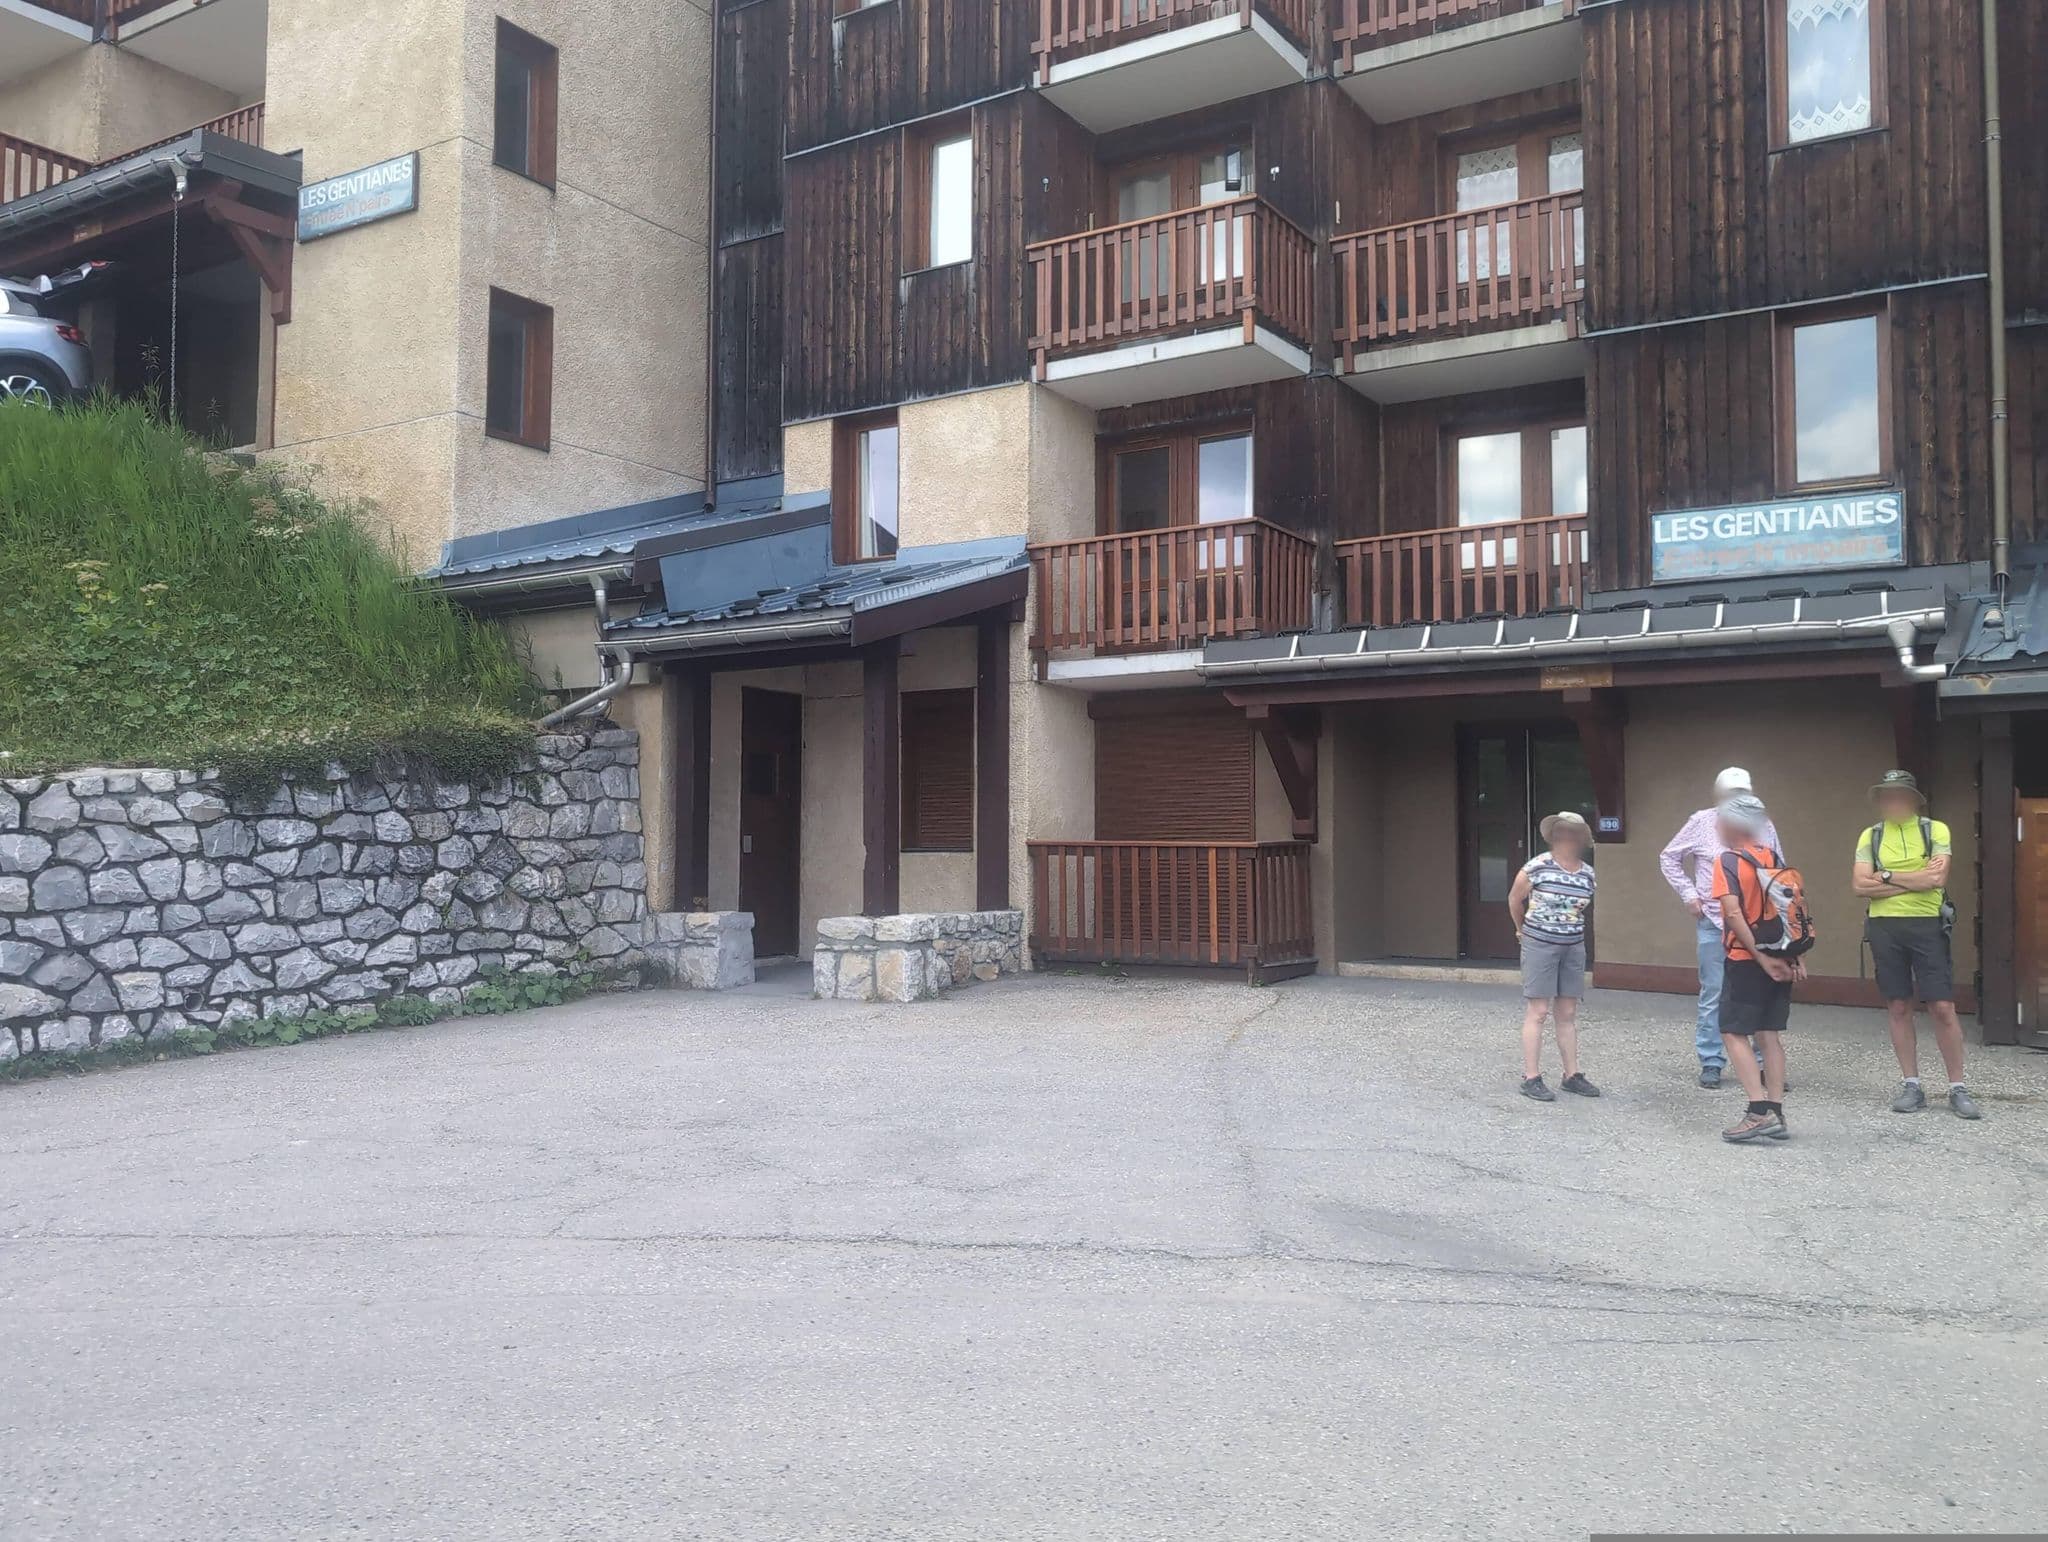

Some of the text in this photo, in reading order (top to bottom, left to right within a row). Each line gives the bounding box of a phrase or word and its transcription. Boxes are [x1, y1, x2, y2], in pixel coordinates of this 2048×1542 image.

[300, 160, 411, 210] LES GENTIANES
[1654, 498, 1898, 543] LES GENTIANES
